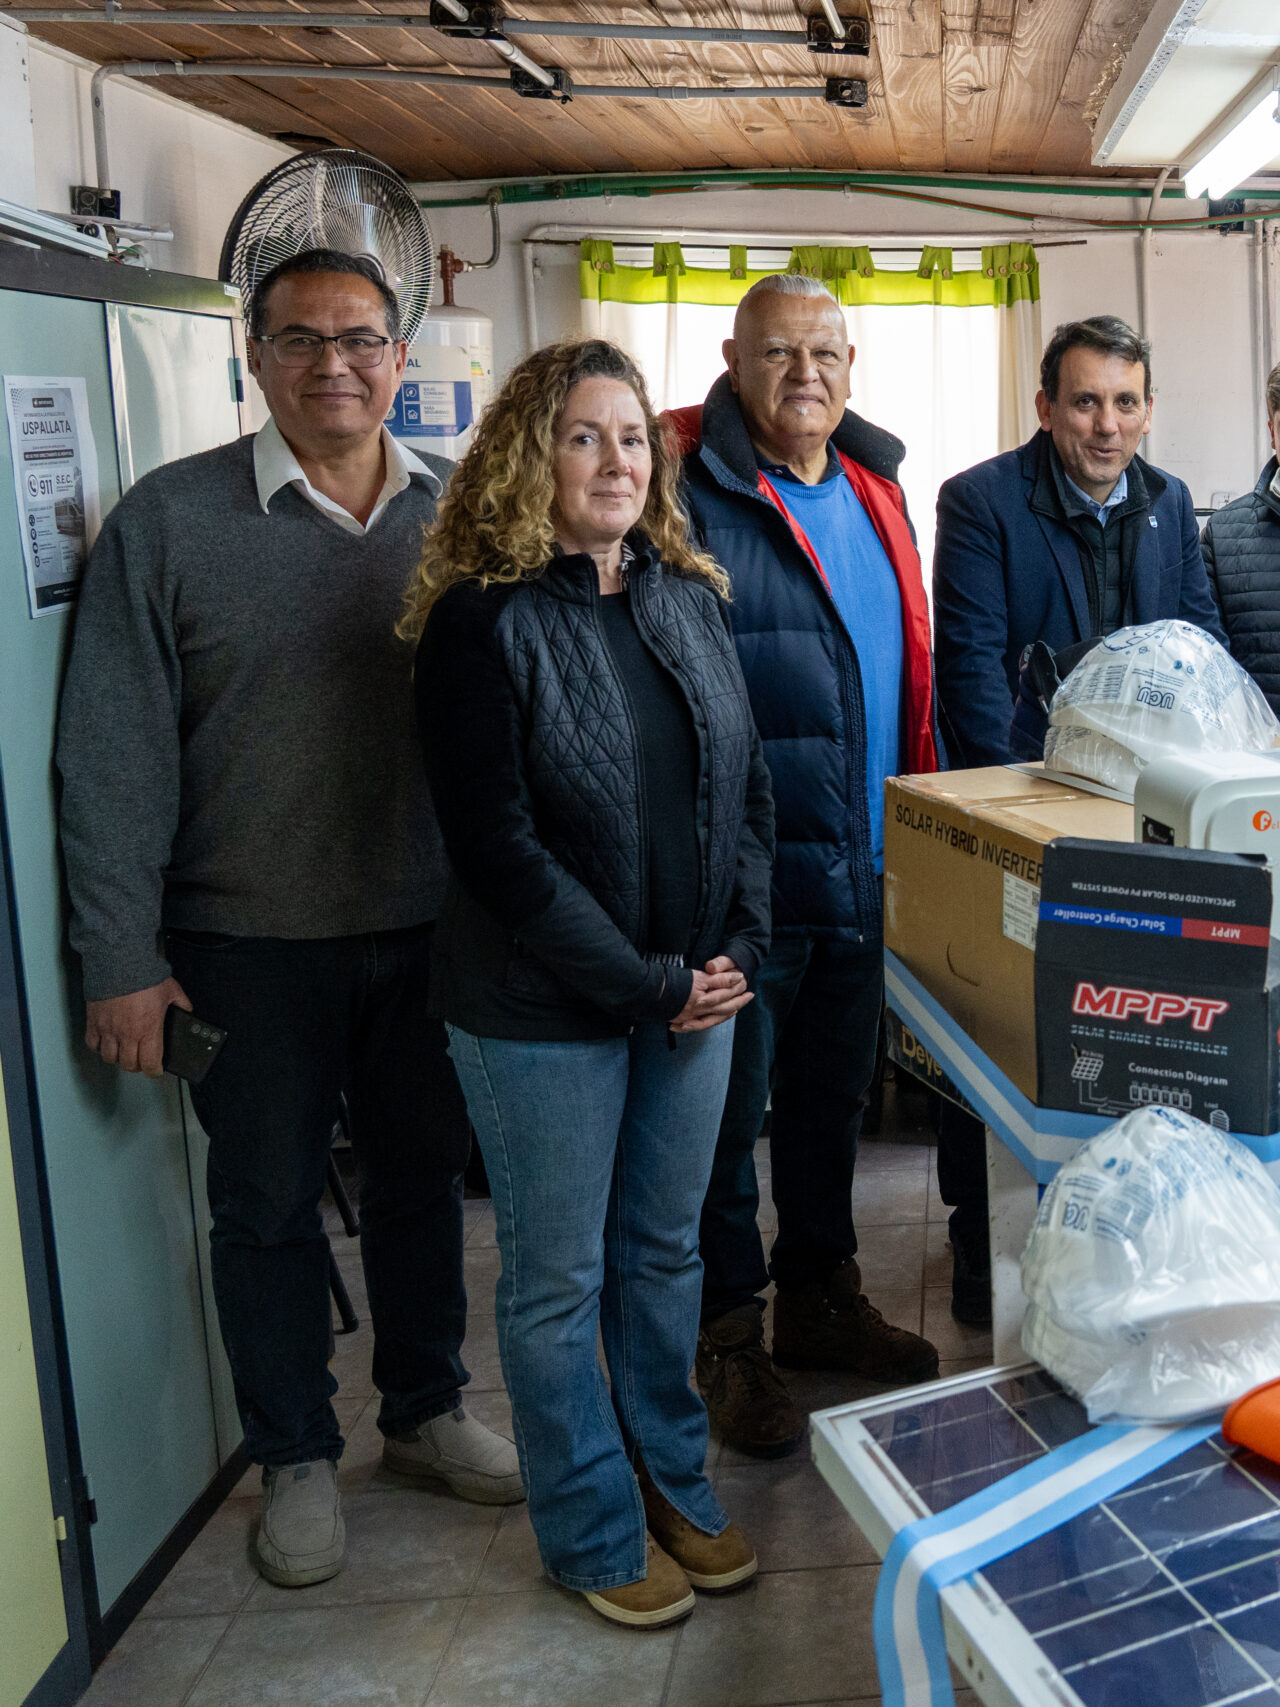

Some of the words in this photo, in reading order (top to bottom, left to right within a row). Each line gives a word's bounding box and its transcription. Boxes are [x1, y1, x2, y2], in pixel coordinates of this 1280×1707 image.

[22, 420, 72, 435] USPALLATA
[40, 479, 53, 495] 911
[56, 475, 73, 485] S.E.C.
[896, 804, 933, 836] SOLAR
[935, 820, 978, 856] HYBRID
[1072, 881, 1101, 892] SYSTEM
[1102, 884, 1129, 895] POWER
[1130, 887, 1141, 897] PV
[1142, 889, 1167, 900] SOLAR
[1168, 891, 1184, 901] FOR
[1185, 894, 1236, 907] SPECIALIZED
[1053, 908, 1102, 924] Controller
[1104, 911, 1138, 928] Charge
[1140, 919, 1165, 931] Solar
[1211, 926, 1240, 939] MPPT
[1072, 982, 1230, 1032] MPPT
[1071, 1024, 1104, 1038] SOLAR
[1128, 1062, 1184, 1081] Connection
[1186, 1071, 1228, 1086] Diagram
